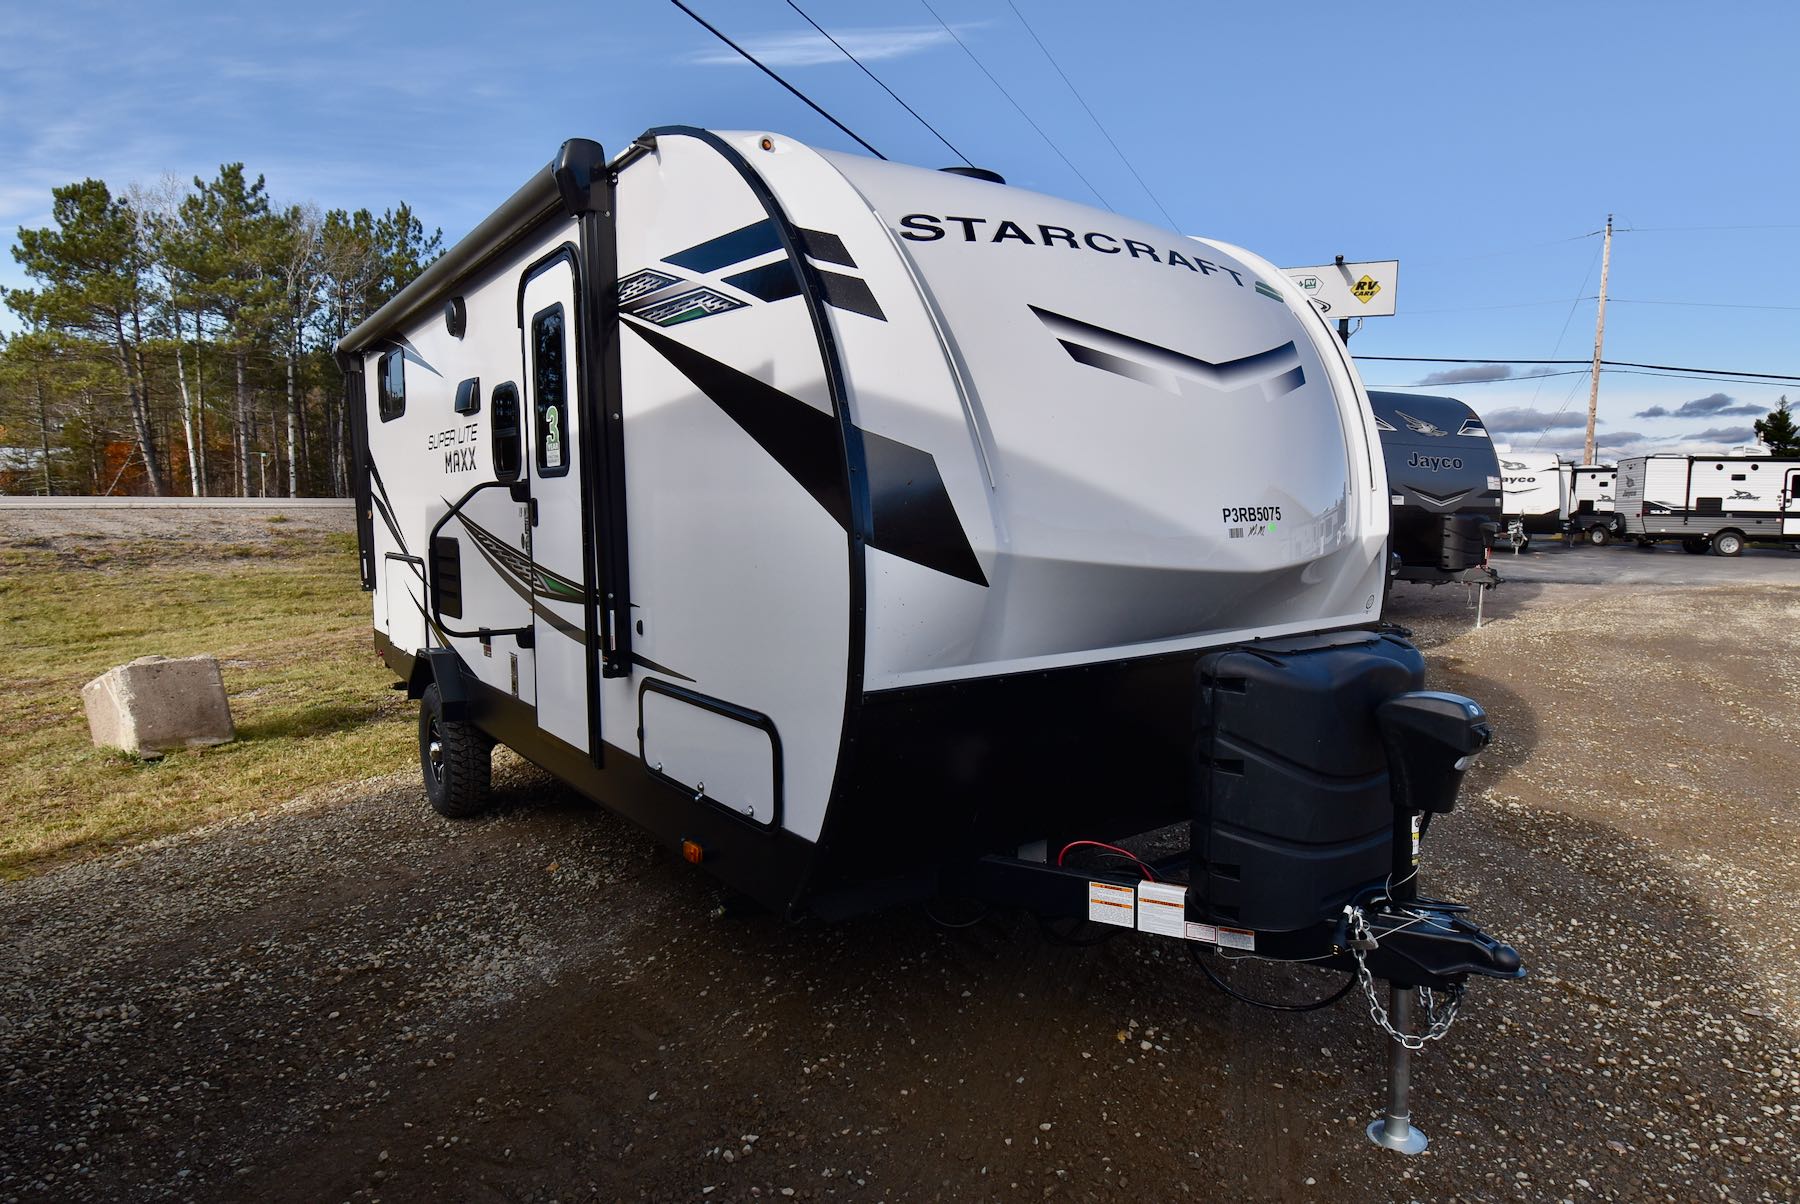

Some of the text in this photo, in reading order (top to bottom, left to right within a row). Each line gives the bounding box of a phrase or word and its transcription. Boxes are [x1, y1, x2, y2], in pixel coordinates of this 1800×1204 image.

[900, 213, 1244, 287] STARCRAFT
[1355, 281, 1378, 290] RV
[428, 423, 478, 450] SUPER LITE
[546, 406, 560, 443] 3
[445, 446, 477, 474] MAXX
[1408, 452, 1463, 472] Jayco
[1222, 506, 1282, 523] P3RB5075
